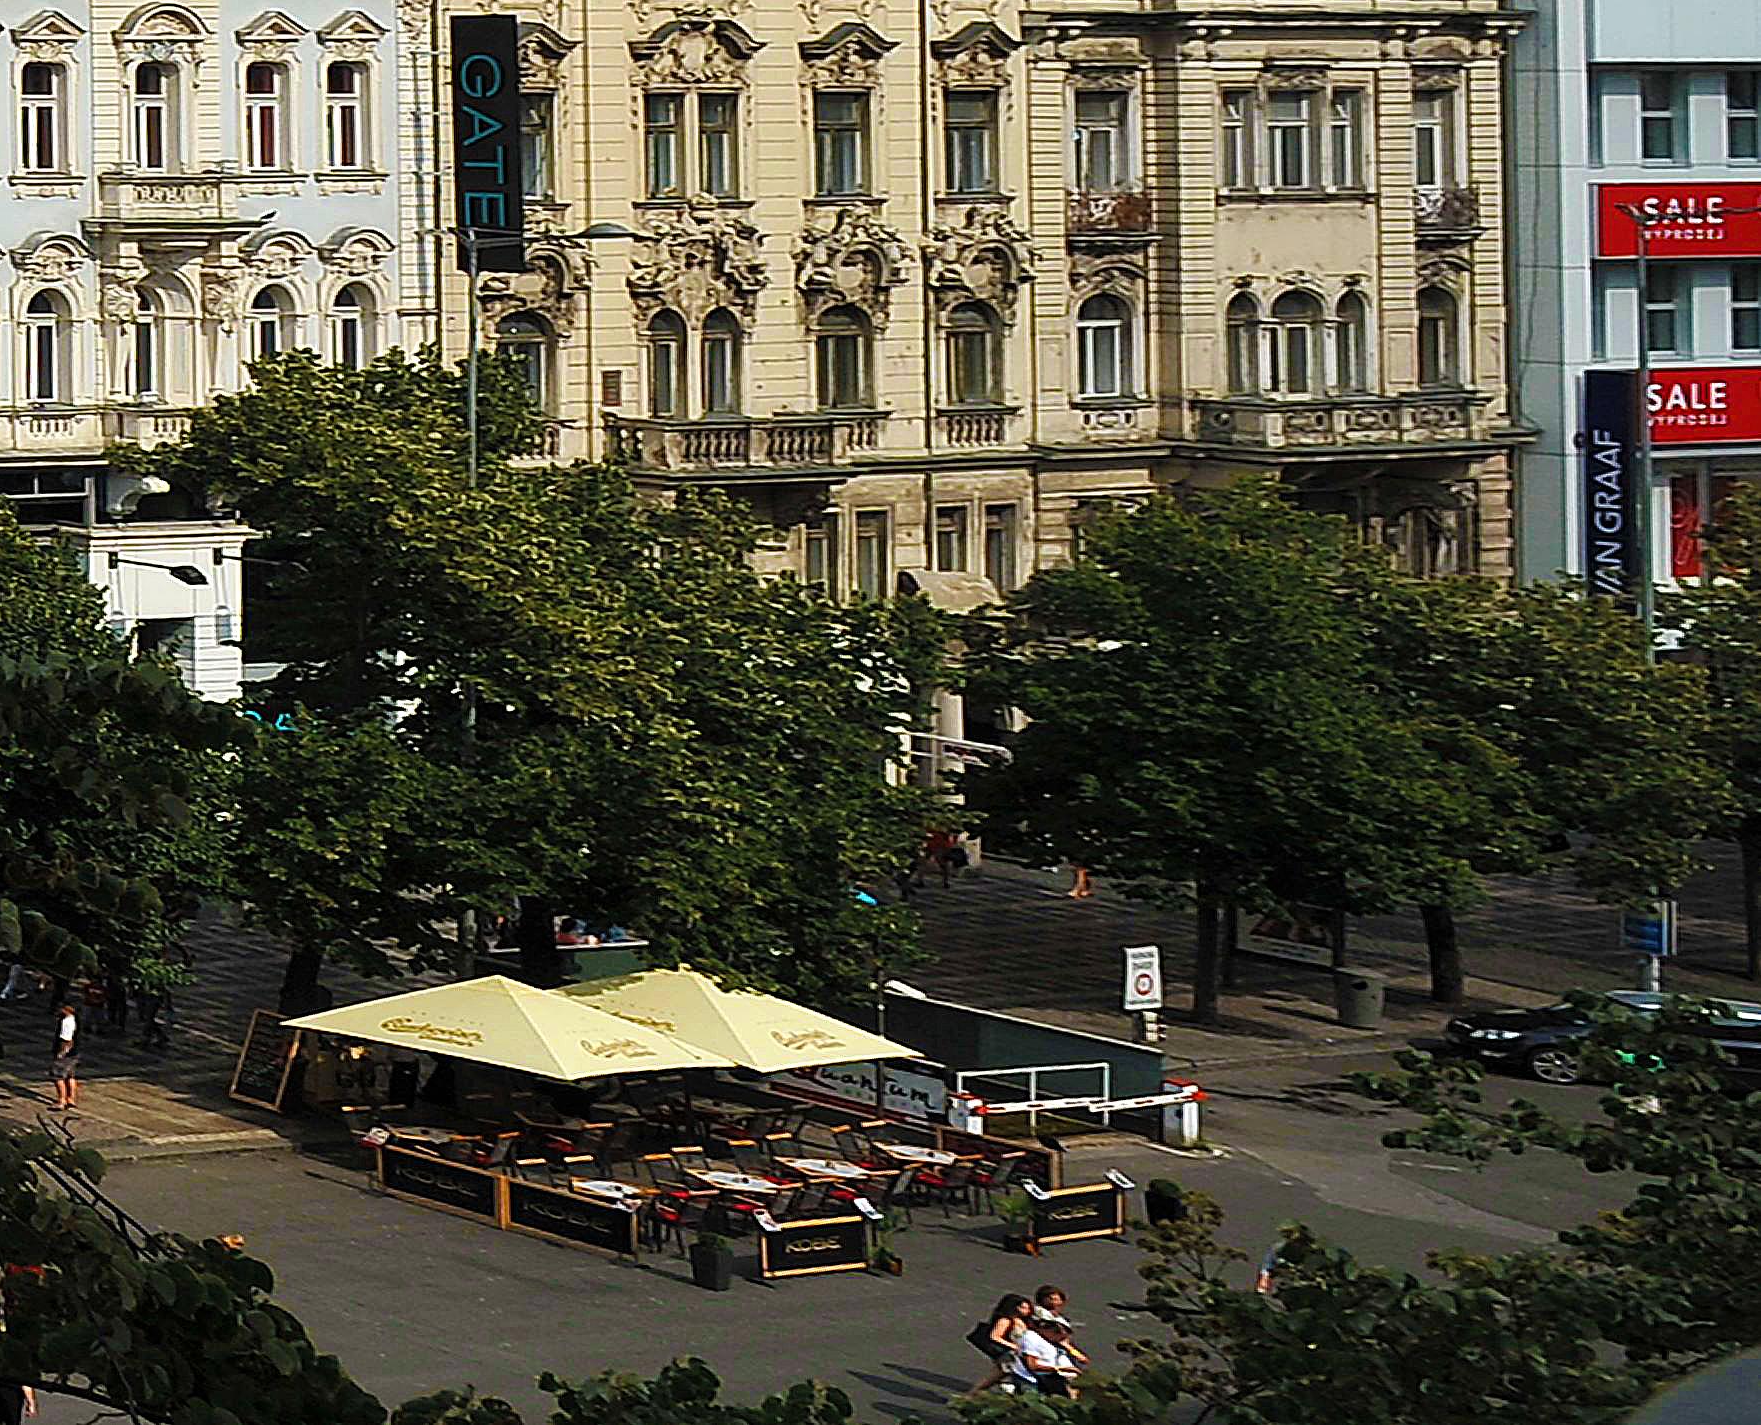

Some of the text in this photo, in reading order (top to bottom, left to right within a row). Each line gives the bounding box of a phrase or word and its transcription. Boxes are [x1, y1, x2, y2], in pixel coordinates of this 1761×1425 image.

[460, 54, 505, 228] GATE
[1643, 197, 1725, 225] SALE
[1646, 382, 1727, 412] SALE
[1592, 429, 1623, 535] GRAAF
